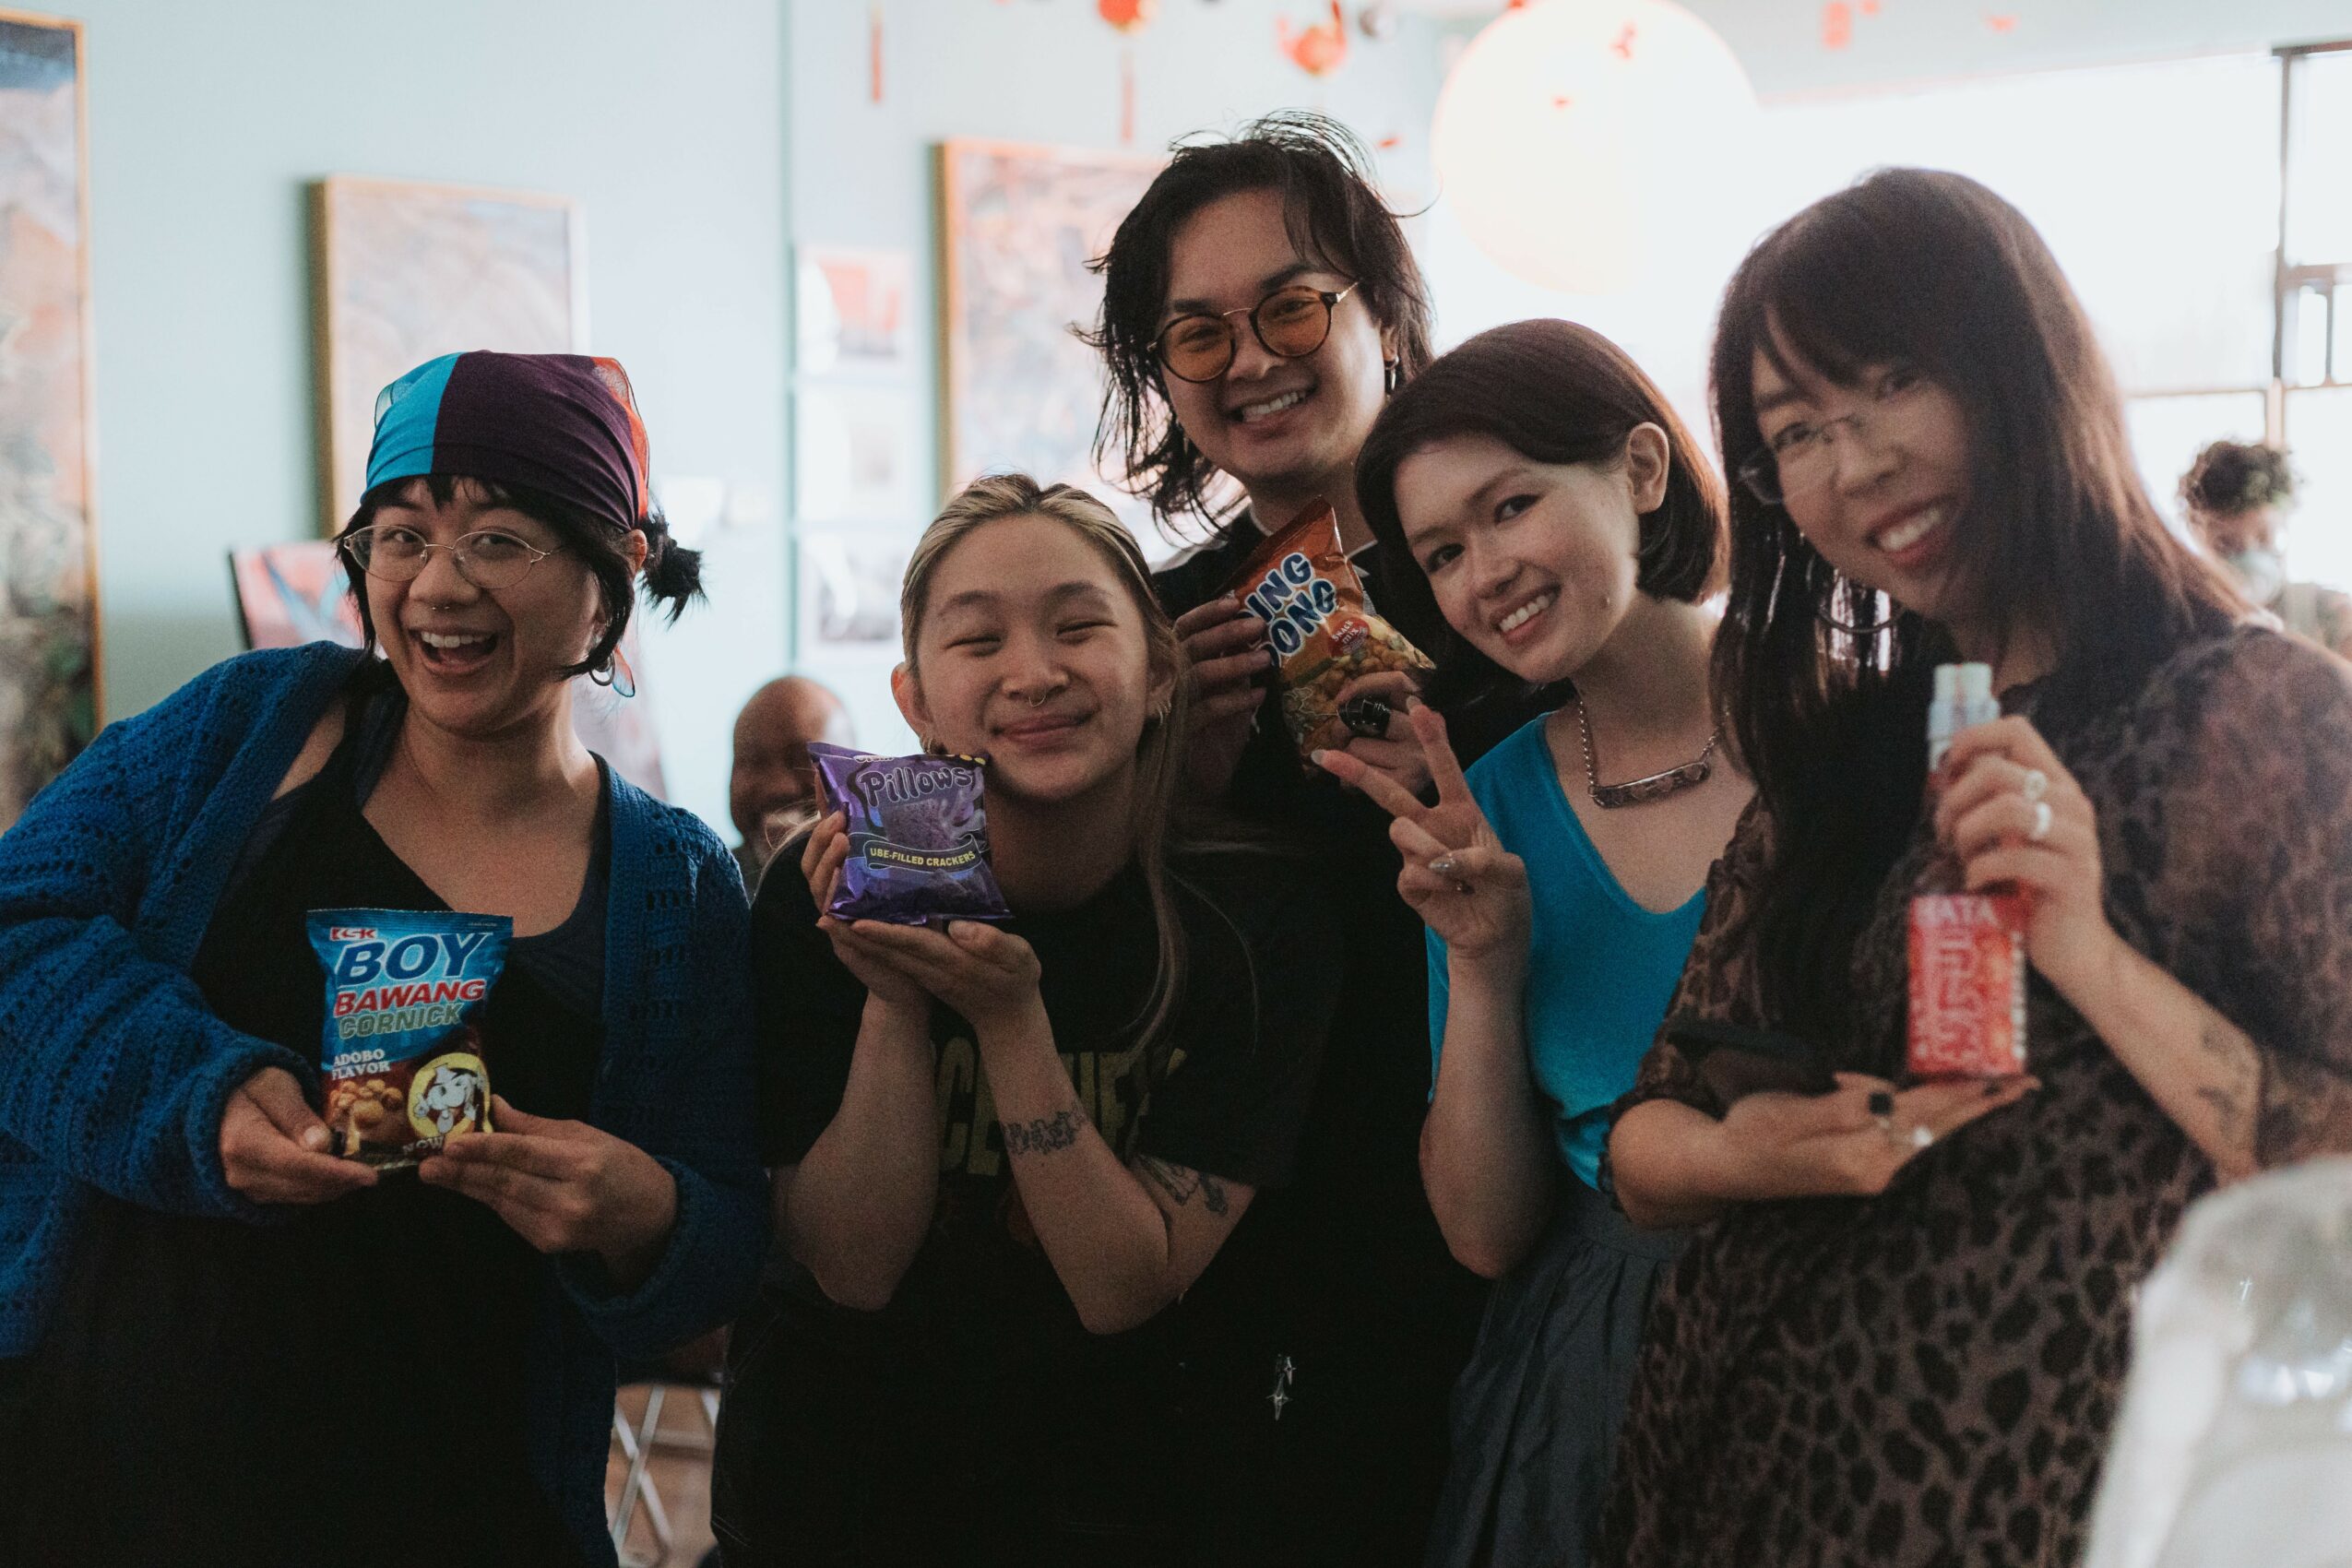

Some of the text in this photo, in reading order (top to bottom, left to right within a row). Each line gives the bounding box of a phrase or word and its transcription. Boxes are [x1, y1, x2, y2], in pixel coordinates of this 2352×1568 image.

[1239, 552, 1313, 625] ING
[1257, 578, 1336, 668] ONG
[1331, 620, 1353, 642] SNACK
[858, 767, 973, 806] Pillows
[926, 850, 976, 867] CRACKERS
[336, 932, 493, 987] BOY
[333, 979, 486, 1018] BAWANG
[339, 1004, 463, 1039] CORNICK
[332, 1061, 391, 1080] FLAVOR
[334, 1049, 385, 1067] ADOBO
